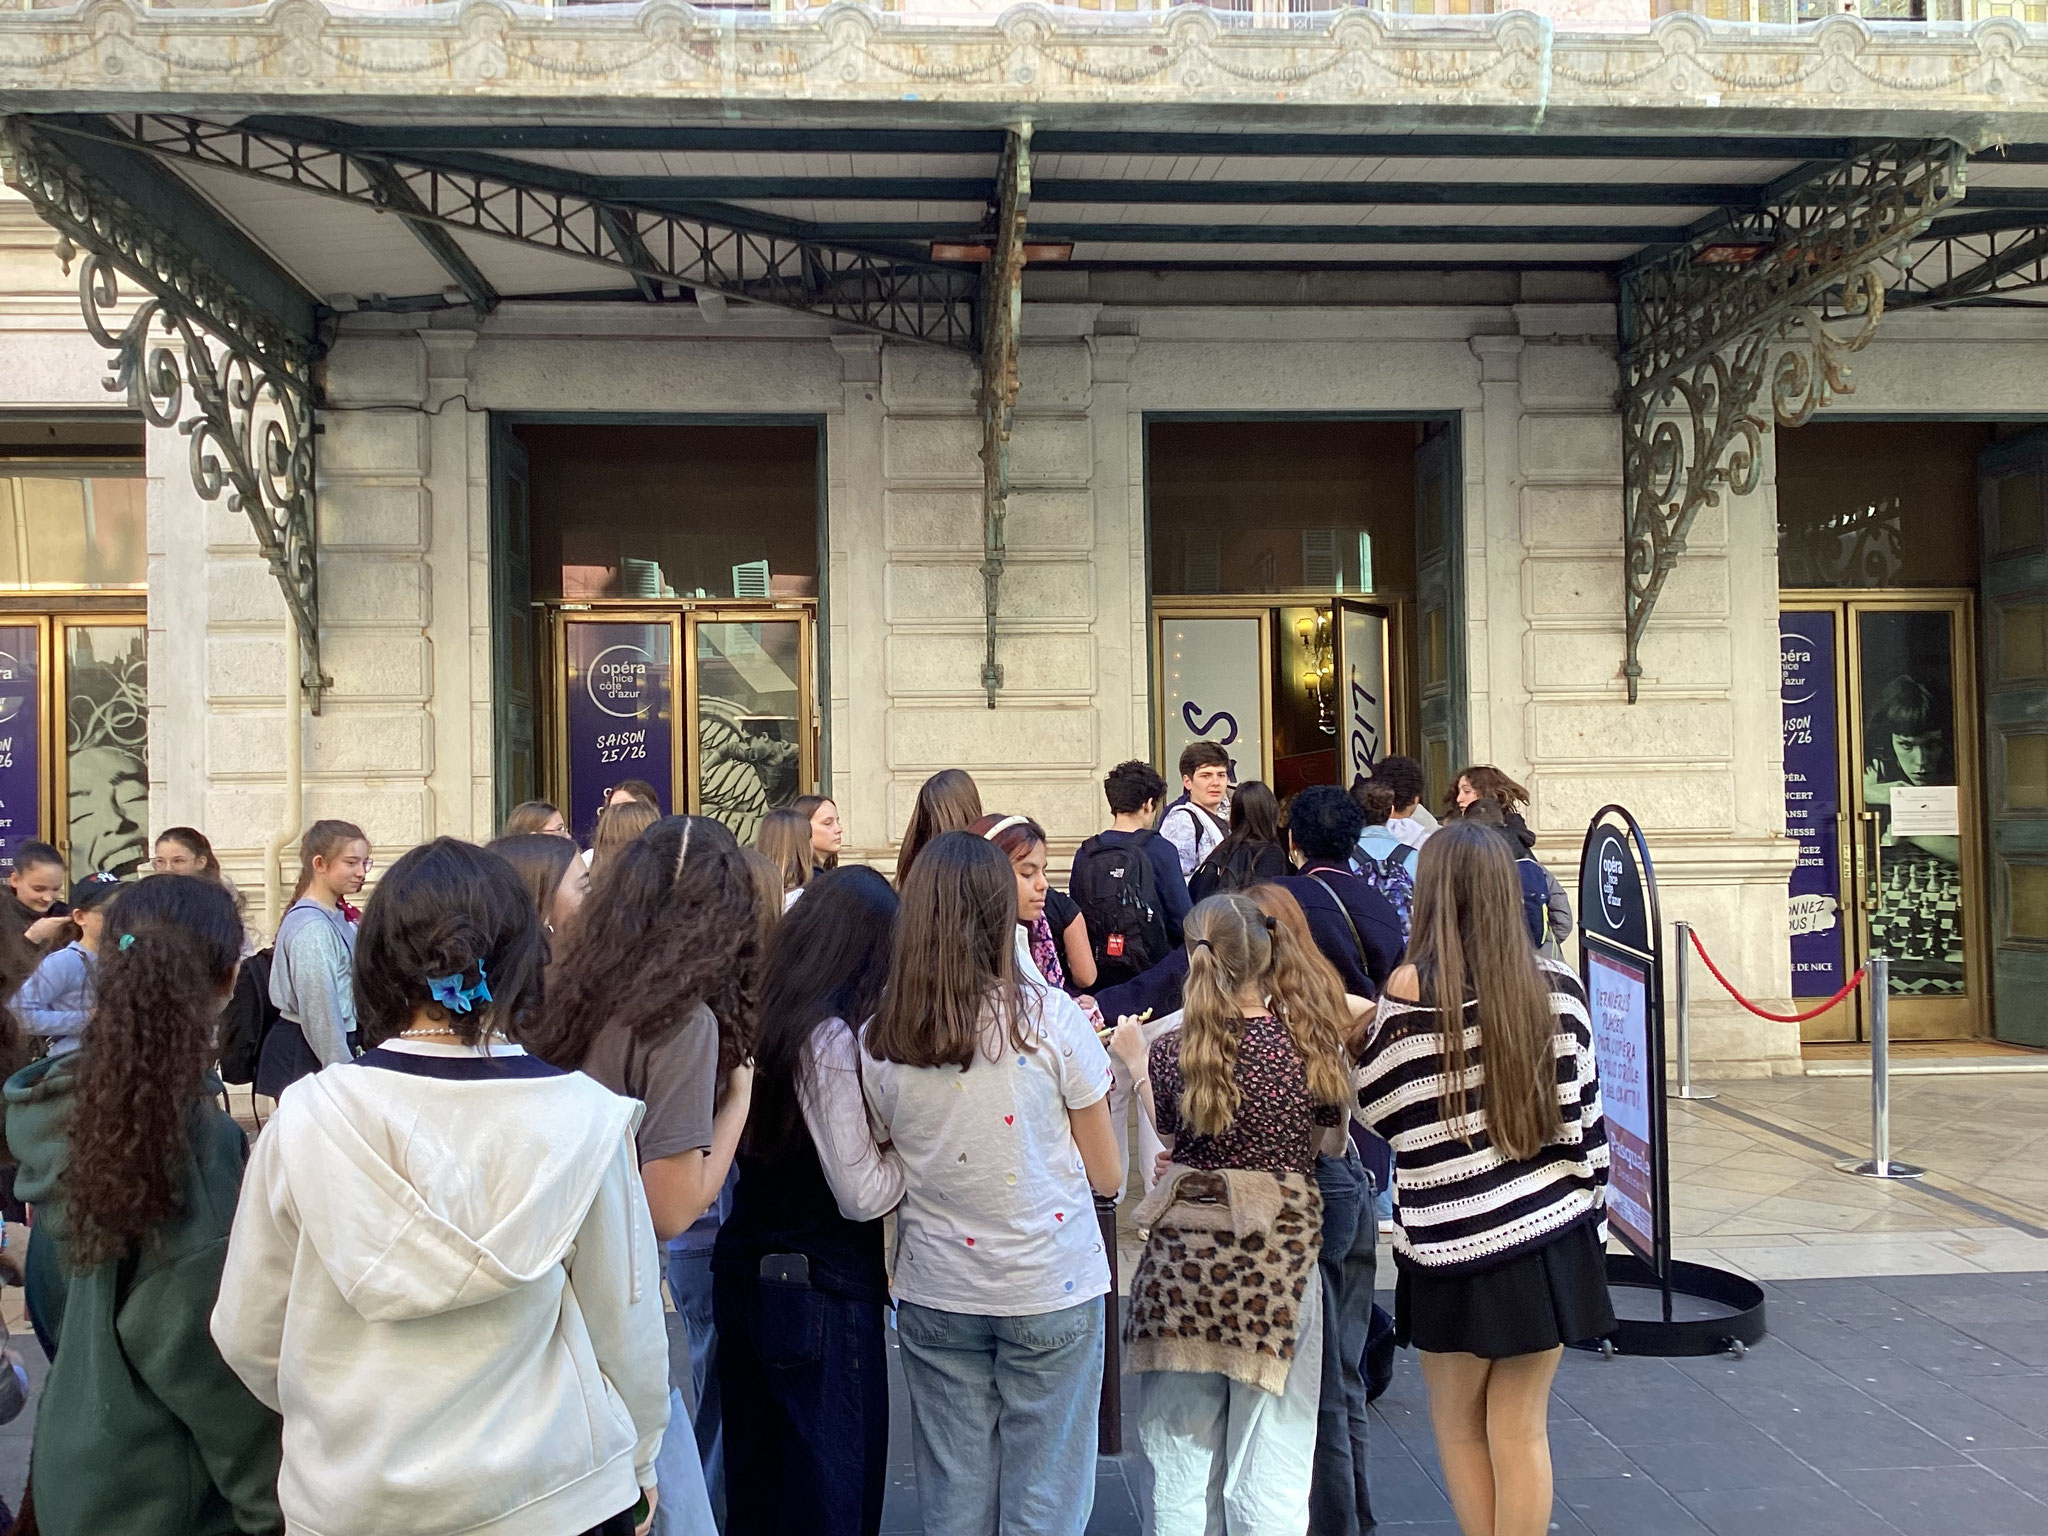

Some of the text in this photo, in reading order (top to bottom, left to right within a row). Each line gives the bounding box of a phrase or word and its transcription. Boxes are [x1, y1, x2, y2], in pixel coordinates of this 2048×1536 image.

[601, 661, 646, 677] opéra
[612, 675, 633, 683] nice
[599, 681, 622, 691] côte
[608, 689, 641, 699] d'azur
[1784, 715, 1811, 731] ISON
[596, 729, 645, 749] SAISON
[602, 744, 646, 763] 25/26
[1784, 773, 1806, 781] PÉRA
[1785, 792, 1813, 800] NCERT
[1786, 810, 1808, 818] ANSE
[1786, 828, 1815, 836] NESSE
[1603, 856, 1622, 874] opéra
[1797, 963, 1809, 971] DE
[1810, 963, 1832, 971] NICE
